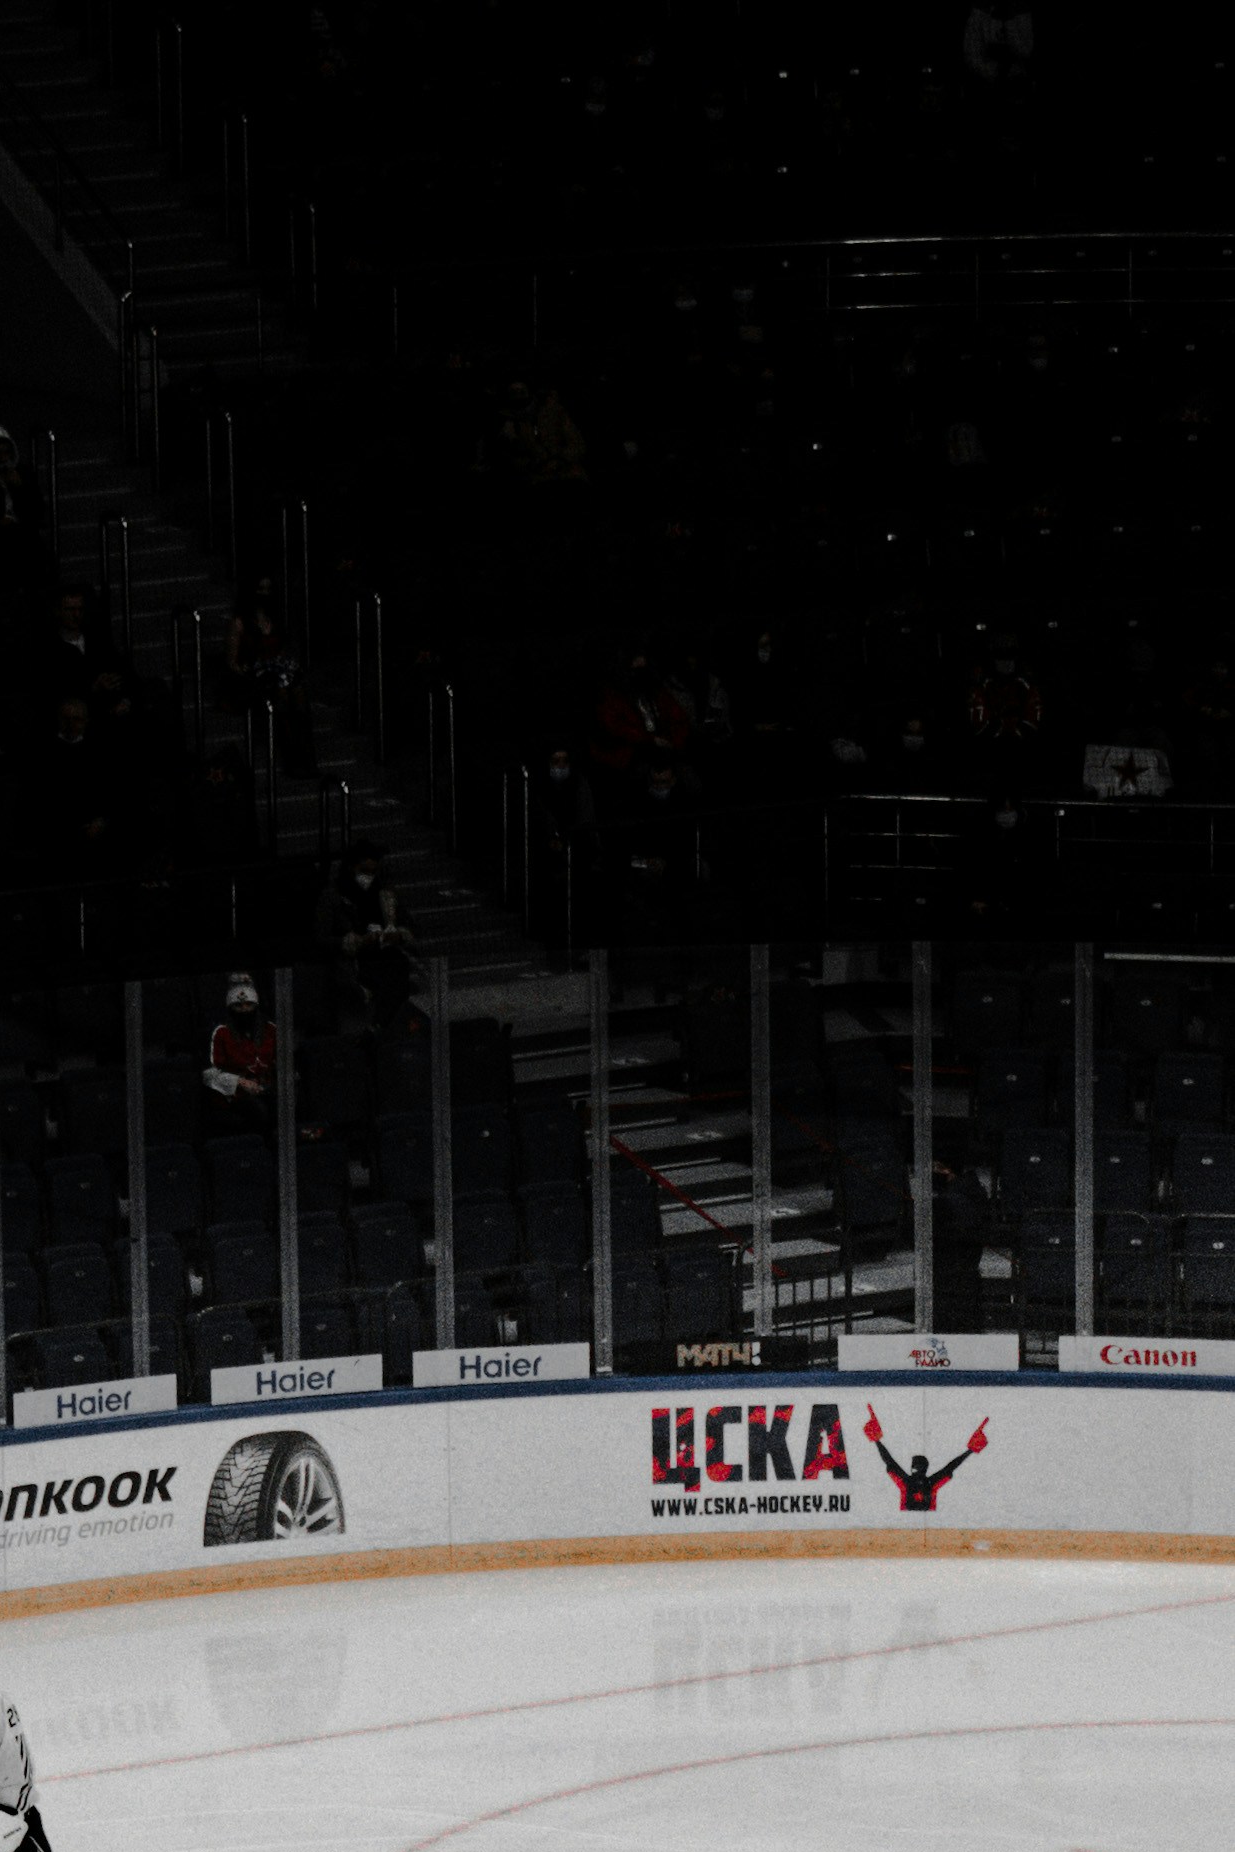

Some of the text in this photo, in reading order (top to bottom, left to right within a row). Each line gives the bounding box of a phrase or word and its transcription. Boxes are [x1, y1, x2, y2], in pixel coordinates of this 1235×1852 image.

[459, 1353, 543, 1380] Haier
[1099, 1344, 1197, 1367] Canon
[256, 1368, 336, 1396] Haier
[56, 1388, 132, 1420] Haier
[651, 1403, 850, 1492] ЦСКА
[651, 1494, 851, 1517] WWW.CSKA-HOCKEY.RU
[78, 1510, 175, 1540] emotion
